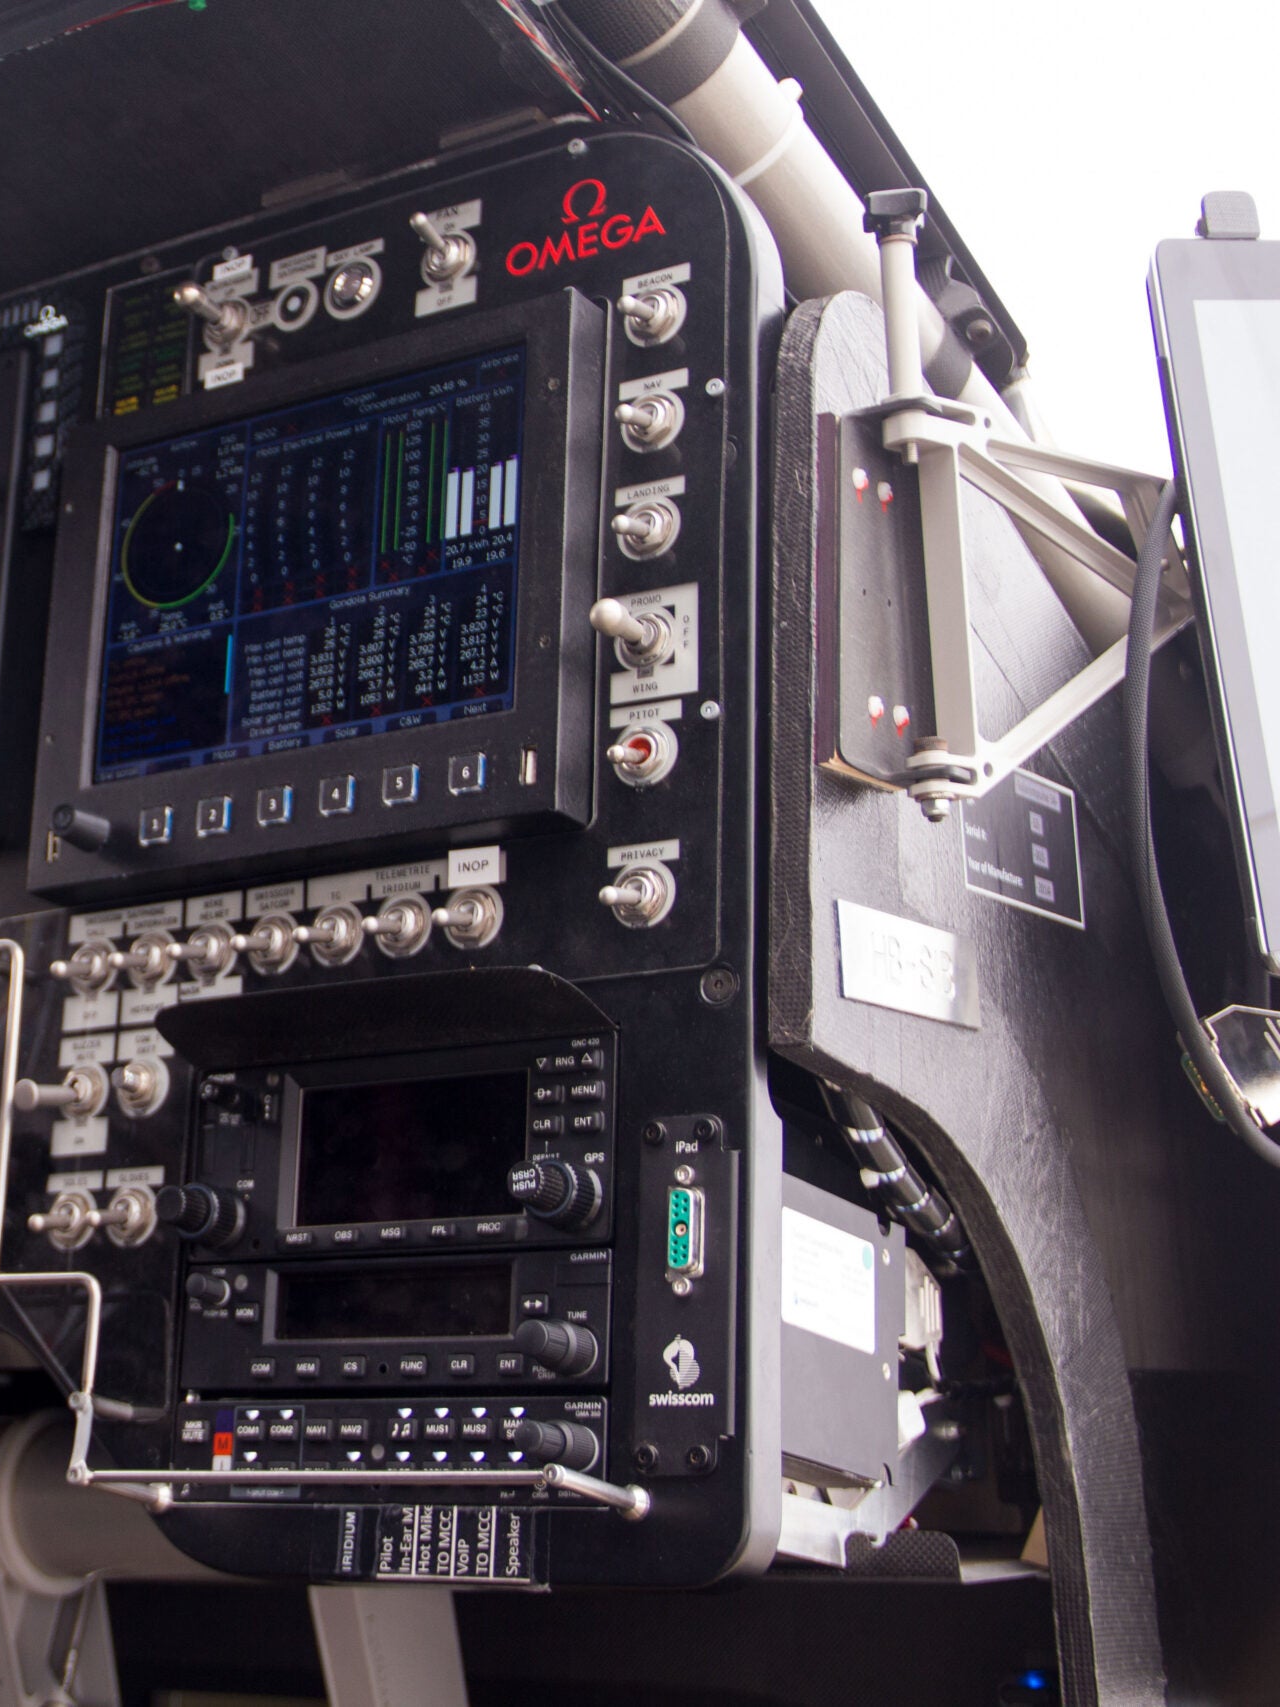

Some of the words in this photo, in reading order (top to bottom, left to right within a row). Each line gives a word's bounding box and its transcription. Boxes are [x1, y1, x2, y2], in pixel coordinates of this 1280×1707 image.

[436, 205, 459, 220] FAN
[505, 205, 667, 276] OMEGA
[221, 260, 246, 273] INOP
[637, 272, 673, 289] BEACON
[437, 296, 453, 306] OFF
[211, 370, 237, 382] INOP
[642, 379, 662, 391] NAV
[456, 393, 491, 407] Battery
[477, 432, 490, 443] 30
[477, 447, 489, 459] 25
[476, 463, 488, 474] 20
[477, 478, 487, 489] 15
[627, 483, 671, 501] LANDING
[476, 494, 486, 505] 10
[446, 543, 466, 556] 20.7
[493, 534, 513, 545] 20.4
[453, 556, 472, 568] 19.9
[486, 549, 506, 561] 19.6
[369, 586, 410, 601] Summary
[475, 594, 488, 606] 24
[630, 593, 662, 607] PROMO
[424, 605, 436, 617] 24
[470, 659, 486, 671] 4.2
[463, 673, 486, 686] 1133
[632, 681, 658, 694] WING
[251, 689, 283, 701] Battery
[249, 702, 281, 714] Battery
[465, 703, 488, 714] Next
[629, 708, 660, 720] PITOT
[336, 727, 359, 739] Solar
[269, 740, 302, 752] Battery
[212, 749, 236, 760] Motor
[461, 763, 470, 779] 6
[395, 775, 403, 790] 5
[330, 785, 340, 800] 4
[268, 797, 276, 812] 3
[207, 808, 216, 822] 2
[150, 816, 159, 831] 1
[620, 847, 665, 862] PRIVACY
[457, 859, 490, 873] INOP
[968, 855, 981, 873] Year
[987, 863, 1024, 889] Manufacture:
[375, 864, 430, 881] TELEMETRIE
[383, 881, 422, 894] IRIDIUM
[571, 1040, 587, 1048] GNC
[588, 1038, 600, 1047] 420
[555, 1056, 574, 1066] RNG
[571, 1085, 597, 1096] MENU
[533, 1119, 551, 1129] CLR
[574, 1117, 593, 1127] ENT
[675, 1140, 698, 1154] iPad
[584, 1152, 605, 1163] GPS
[118, 1171, 150, 1183] GLOVES
[512, 1168, 536, 1180] CRSR
[236, 1179, 255, 1190] COM
[512, 1180, 536, 1192] PUSH
[380, 1226, 401, 1238] MSG
[431, 1224, 447, 1235] FPL
[476, 1221, 501, 1233] PROC
[285, 1231, 308, 1242] NRST
[334, 1229, 353, 1240] OBS
[570, 1251, 607, 1262] GARMIN
[235, 1308, 254, 1317] MON
[567, 1311, 588, 1320] TUNE
[251, 1363, 270, 1371] COM
[296, 1362, 315, 1371] MEM
[343, 1362, 358, 1370] ICS
[400, 1360, 422, 1370] FUNC
[451, 1360, 467, 1369] CLR
[499, 1360, 516, 1369] ENT
[649, 1390, 714, 1407] swisscom
[564, 1402, 602, 1411] GARMIN
[184, 1421, 203, 1429] MKR
[237, 1425, 259, 1434] COM1
[270, 1424, 294, 1434] COM2
[306, 1425, 326, 1434] NAV1
[341, 1425, 362, 1434] NAV2
[426, 1424, 448, 1433] MUS1
[463, 1424, 486, 1433] MUS2
[182, 1431, 204, 1440] MUTE
[217, 1437, 228, 1450] M
[420, 1504, 434, 1541] Mike
[438, 1510, 452, 1549] MCC
[478, 1510, 491, 1549] MCC
[342, 1510, 356, 1572] IRIDIUM
[505, 1512, 521, 1576] Speaker
[379, 1535, 394, 1573] Pilot
[399, 1524, 414, 1573] In-Ear
[418, 1543, 431, 1573] Hot
[437, 1551, 450, 1574] TO
[456, 1538, 470, 1575] VoIP
[476, 1552, 489, 1575] TO
